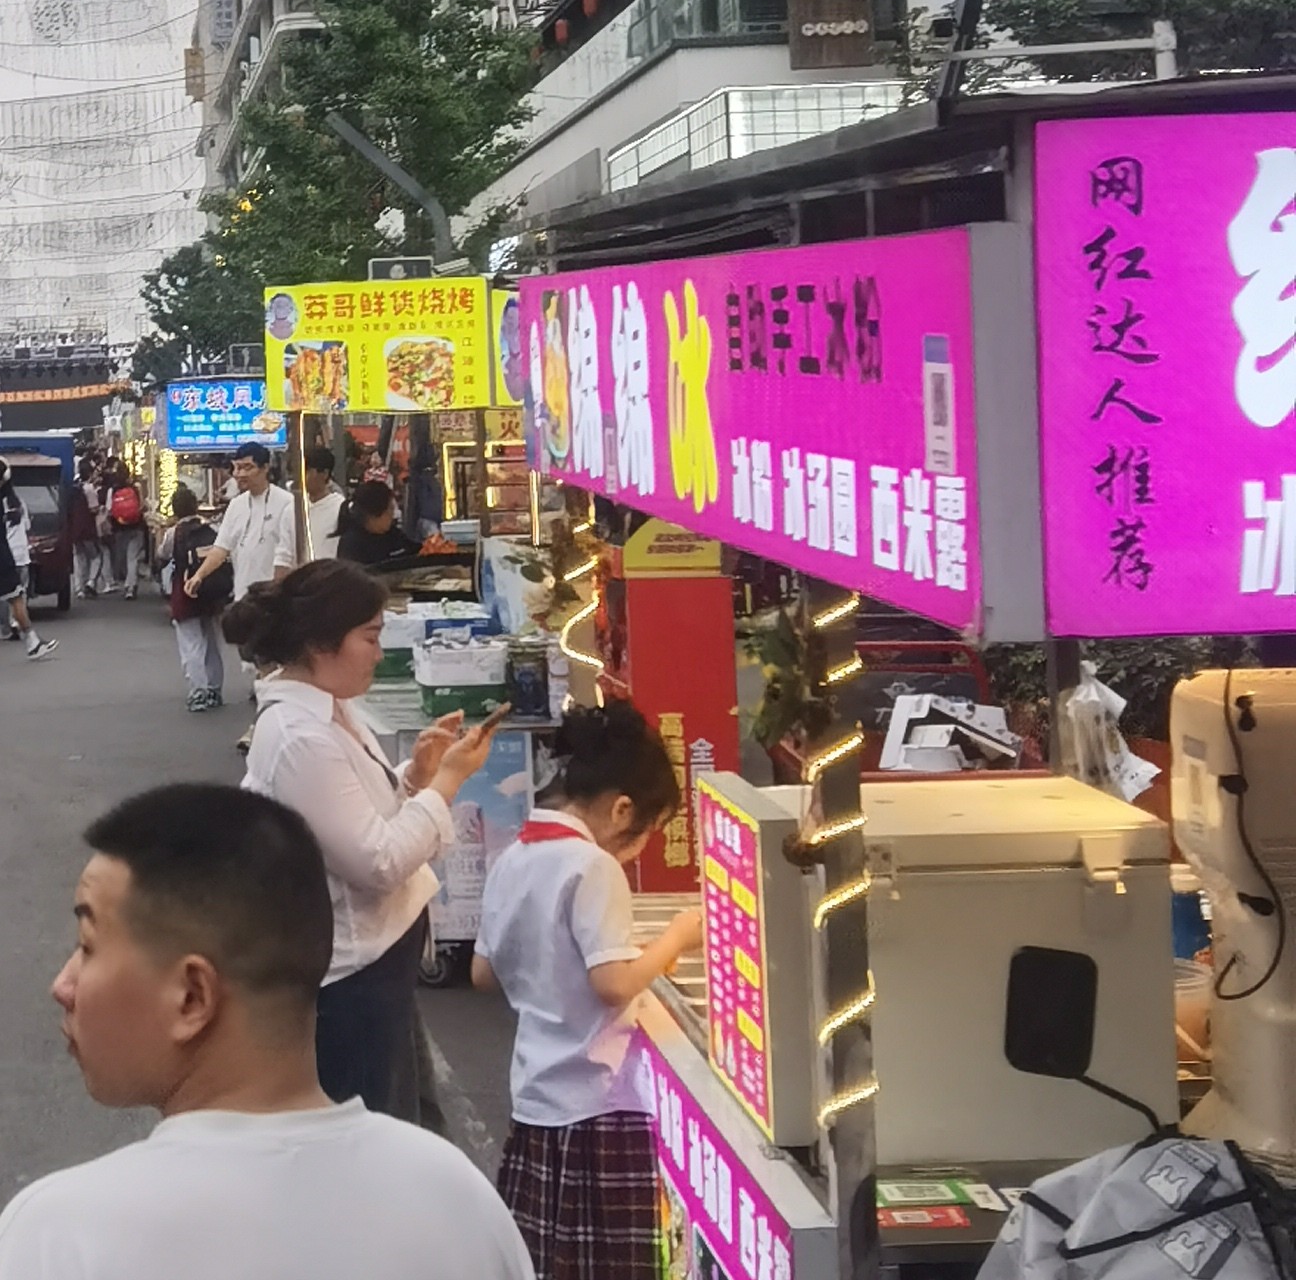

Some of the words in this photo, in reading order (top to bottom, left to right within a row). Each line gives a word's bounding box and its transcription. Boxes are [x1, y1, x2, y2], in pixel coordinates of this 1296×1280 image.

[1082, 155, 1163, 590] 网红达人推荐
[781, 447, 857, 558] 冰汤圆
[870, 464, 967, 592] 西米露
